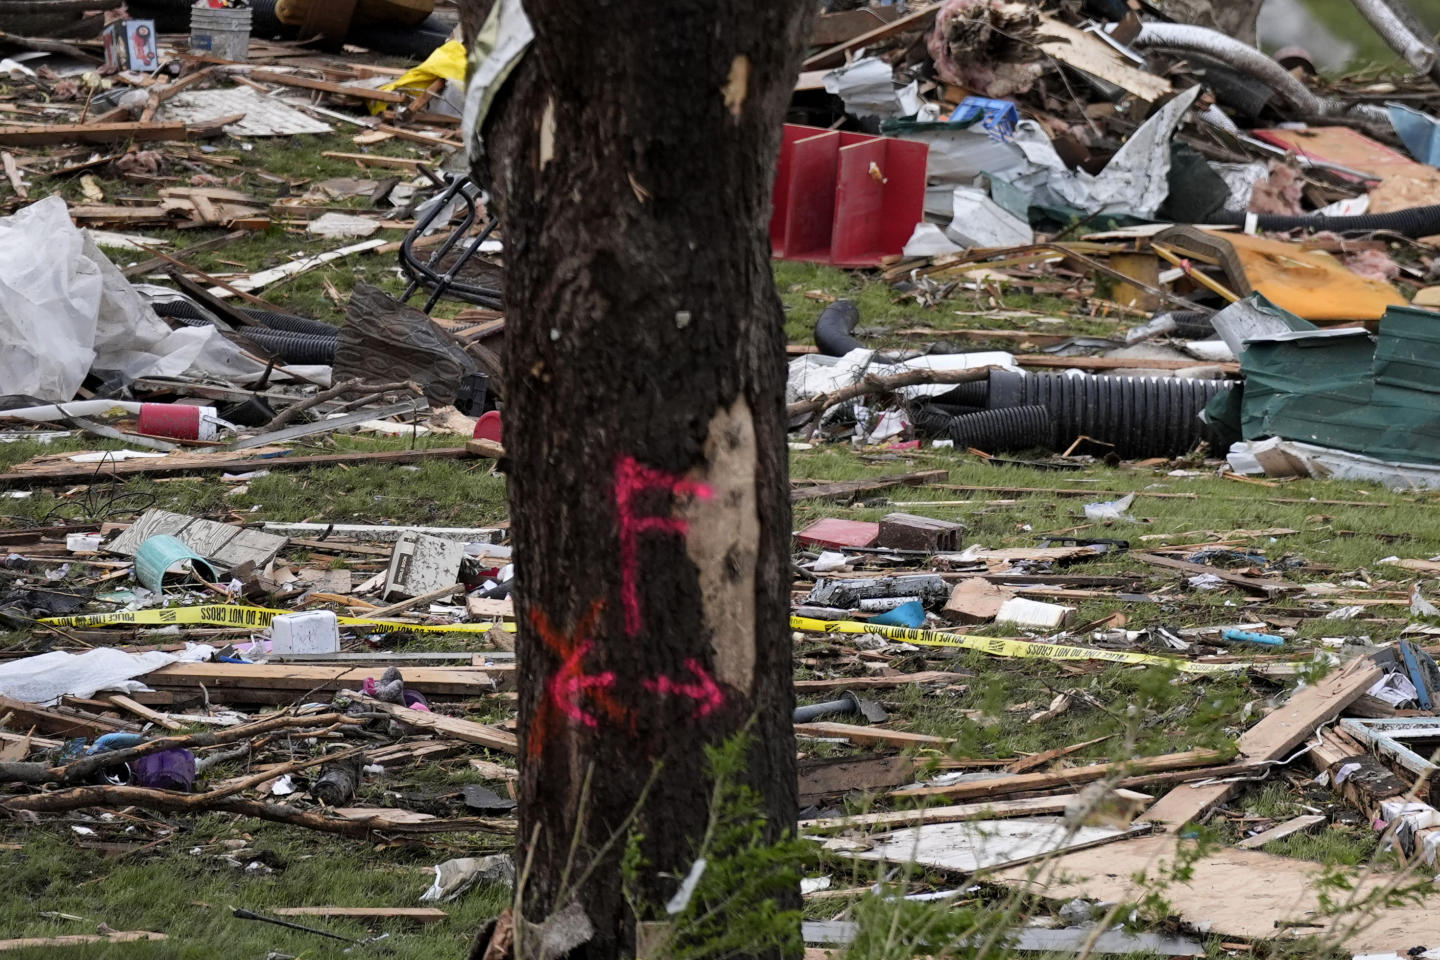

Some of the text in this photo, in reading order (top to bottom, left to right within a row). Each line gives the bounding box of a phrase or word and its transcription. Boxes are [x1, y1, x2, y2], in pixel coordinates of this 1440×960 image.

[615, 453, 718, 637] F
[108, 612, 135, 622] POLICE
[200, 606, 226, 622] CROSS
[229, 608, 244, 624] NOT
[245, 609, 256, 625] DO
[891, 626, 906, 639] NOT
[907, 628, 918, 640] DO
[920, 629, 938, 641] LINE
[939, 632, 967, 644] POLICE
[1026, 643, 1053, 656] CROSS
[1054, 647, 1069, 657] NOT
[1070, 648, 1082, 657] DO
